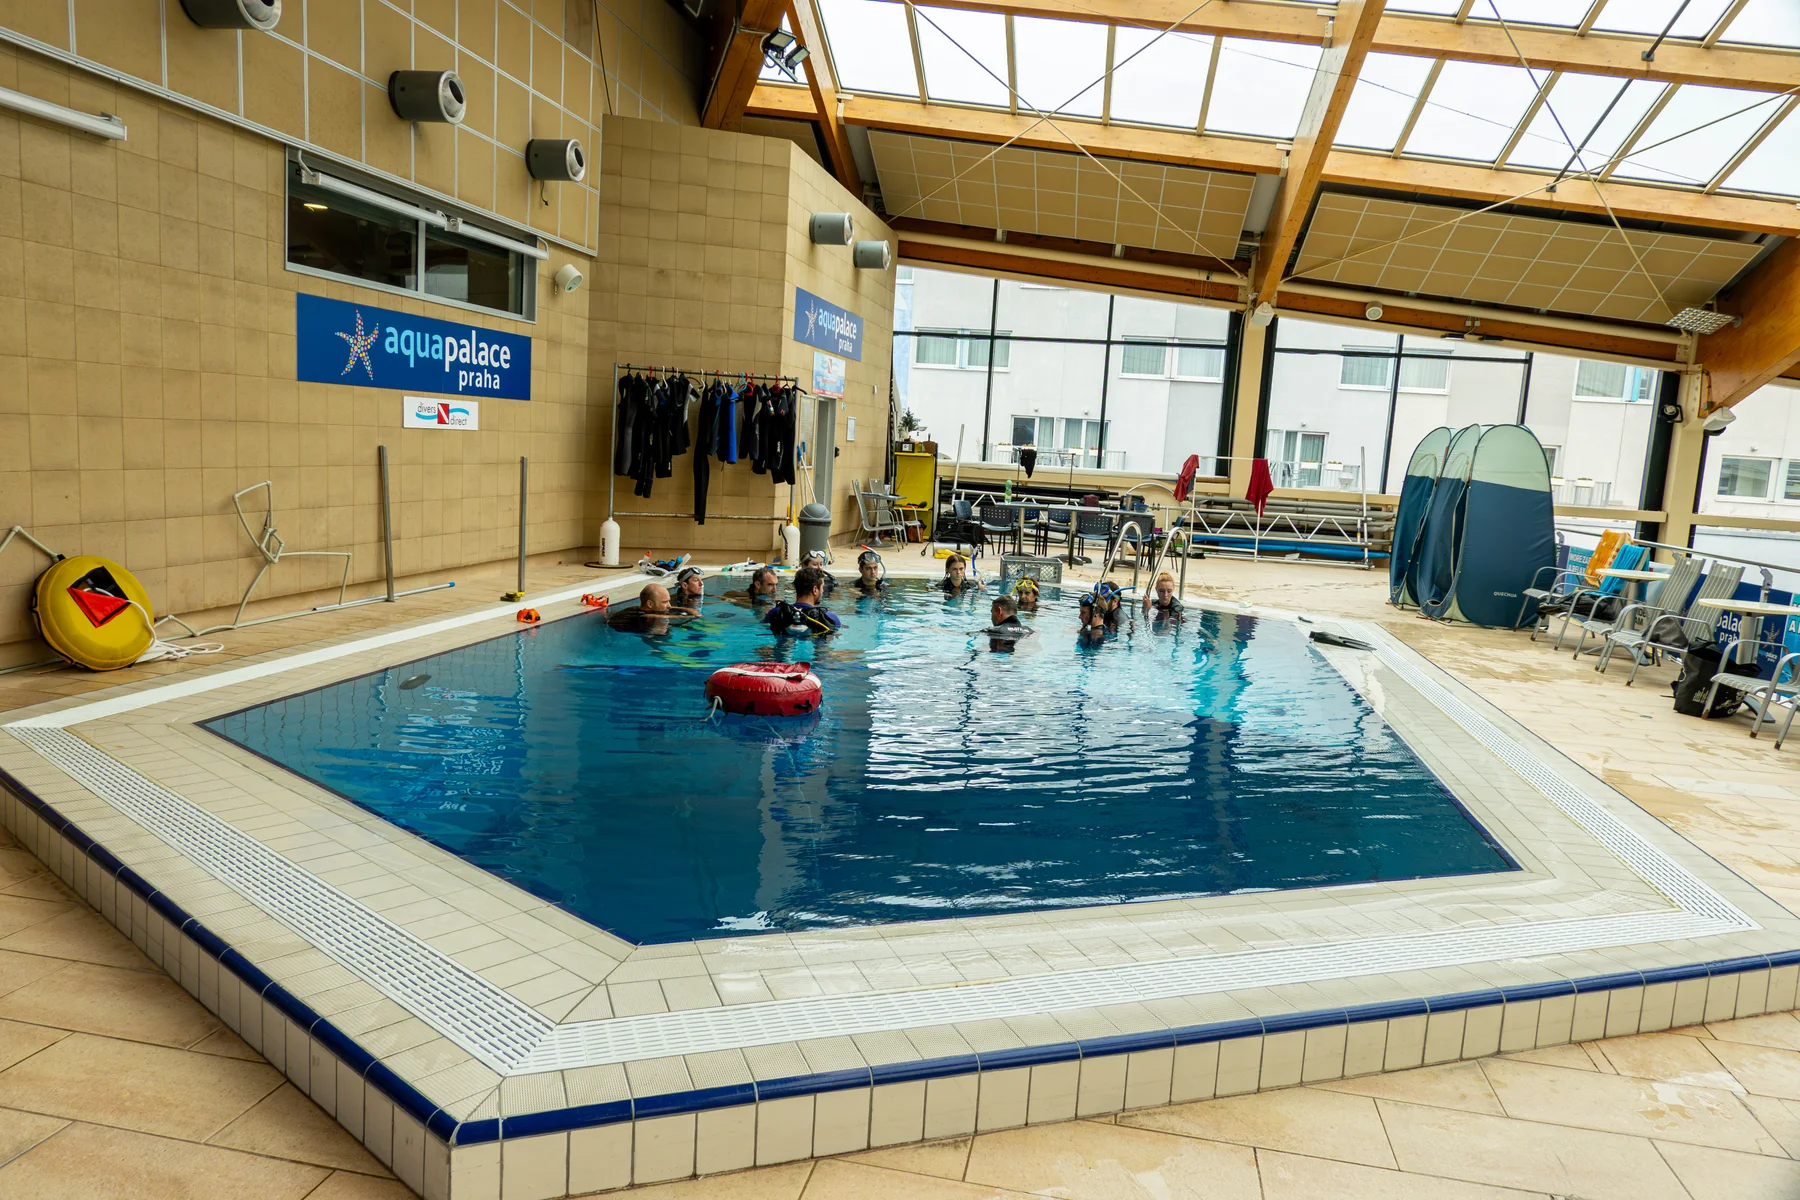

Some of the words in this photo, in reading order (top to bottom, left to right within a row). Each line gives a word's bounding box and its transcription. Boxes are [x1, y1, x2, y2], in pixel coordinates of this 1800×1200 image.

[818, 308, 857, 340] aquapalace
[385, 326, 511, 372] aquapalace
[838, 339, 853, 353] praha
[459, 368, 500, 391] praha
[417, 401, 437, 413] divers
[451, 415, 467, 426] direct
